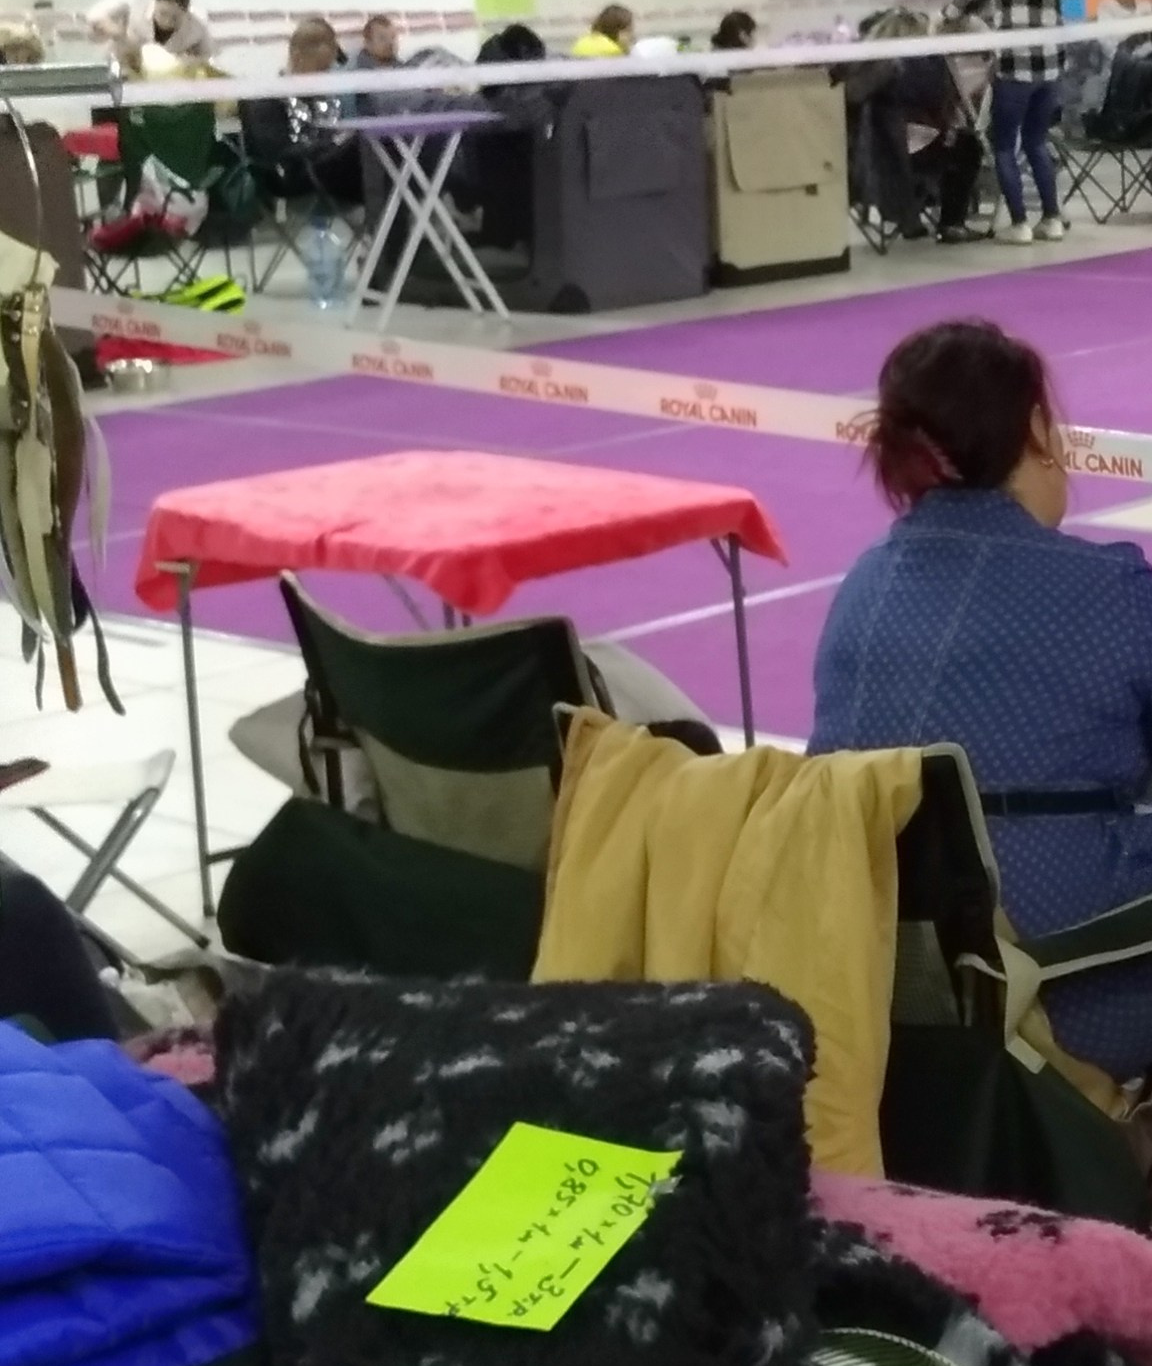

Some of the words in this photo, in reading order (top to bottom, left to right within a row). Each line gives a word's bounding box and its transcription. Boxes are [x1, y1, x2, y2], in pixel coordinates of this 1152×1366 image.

[500, 375, 544, 398] ROYAL
[545, 382, 589, 403] CANIN
[660, 398, 706, 421] ROYAL
[709, 406, 757, 427] CANIN
[1085, 453, 1144, 478] CANIN
